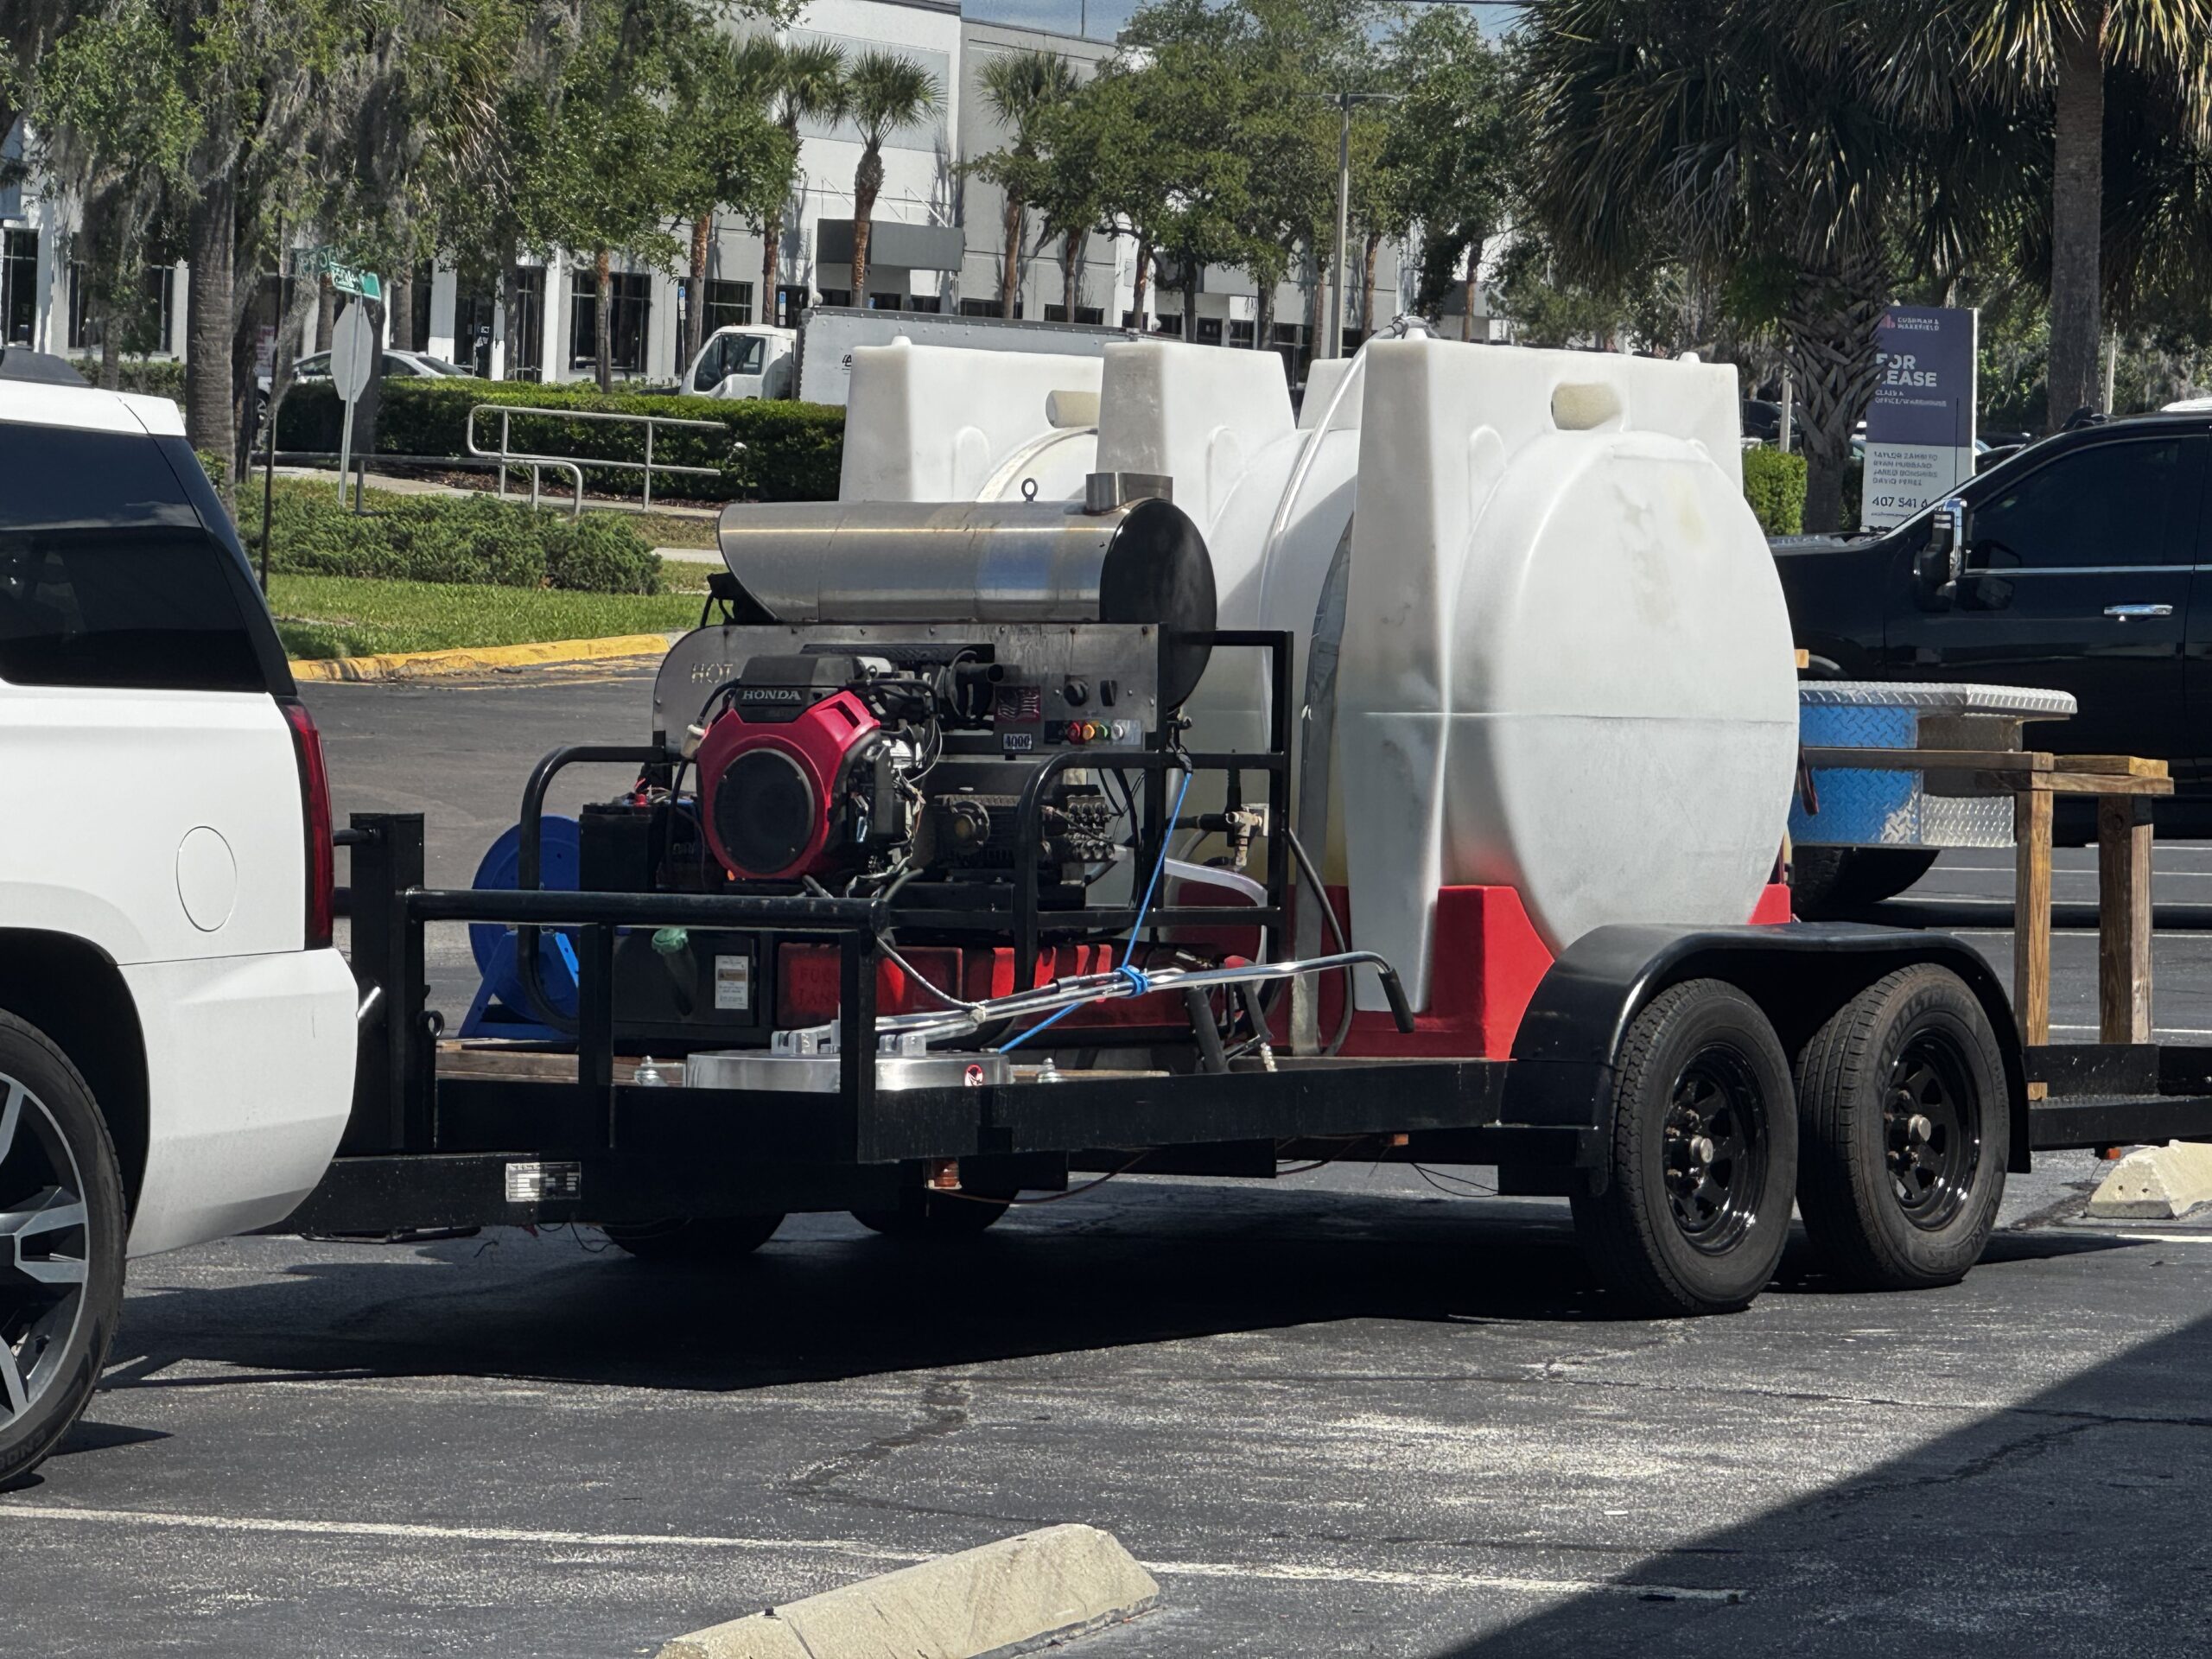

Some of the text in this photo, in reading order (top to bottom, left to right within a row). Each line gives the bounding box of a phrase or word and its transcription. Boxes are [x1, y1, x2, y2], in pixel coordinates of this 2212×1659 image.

[1876, 370, 1937, 387] EASE
[1872, 496, 1895, 507] 407
[691, 663, 734, 683] HOT
[741, 690, 802, 701] HONDA
